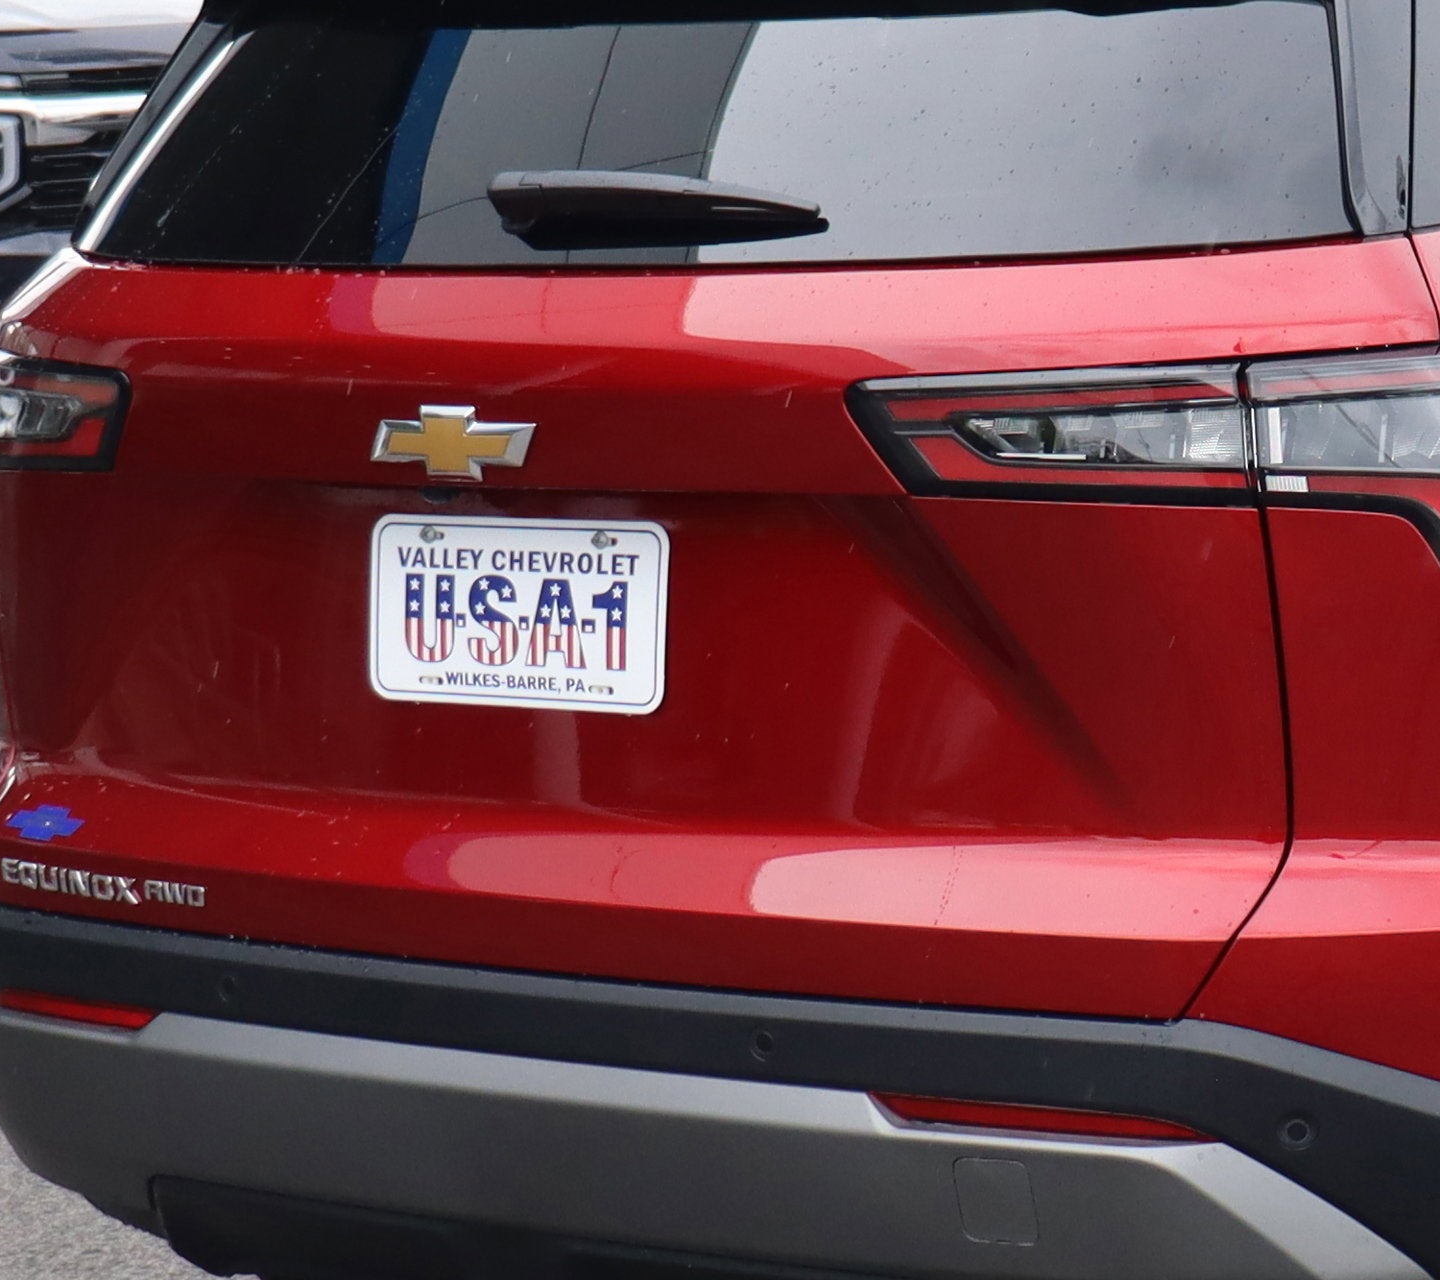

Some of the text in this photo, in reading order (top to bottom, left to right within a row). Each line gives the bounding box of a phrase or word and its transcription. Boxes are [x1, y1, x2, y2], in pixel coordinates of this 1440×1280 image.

[397, 546, 640, 576] VALLEY CHEVROLET
[445, 671, 586, 694] WILKES-BARRE, PA
[0, 857, 207, 908] EQUINOX AWD
